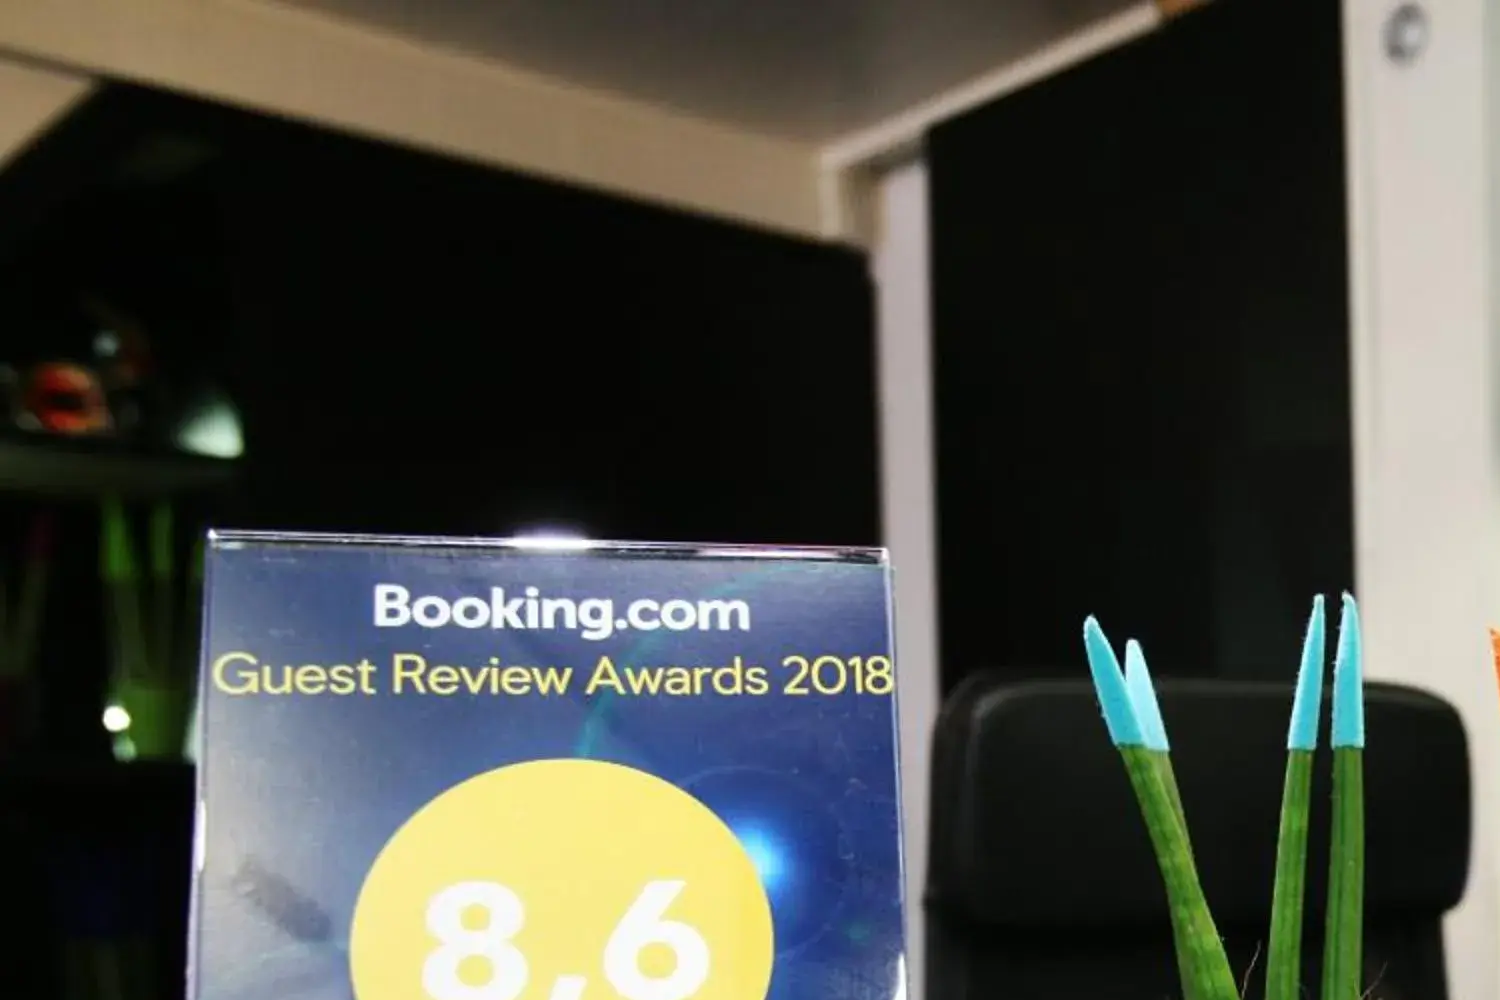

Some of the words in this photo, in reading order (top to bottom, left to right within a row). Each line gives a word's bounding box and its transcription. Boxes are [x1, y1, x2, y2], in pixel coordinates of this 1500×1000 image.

[373, 583, 751, 641] Booking.com
[210, 651, 376, 697] Guest
[392, 653, 573, 697] Review
[586, 654, 770, 697] Awards
[783, 654, 897, 696] 2018
